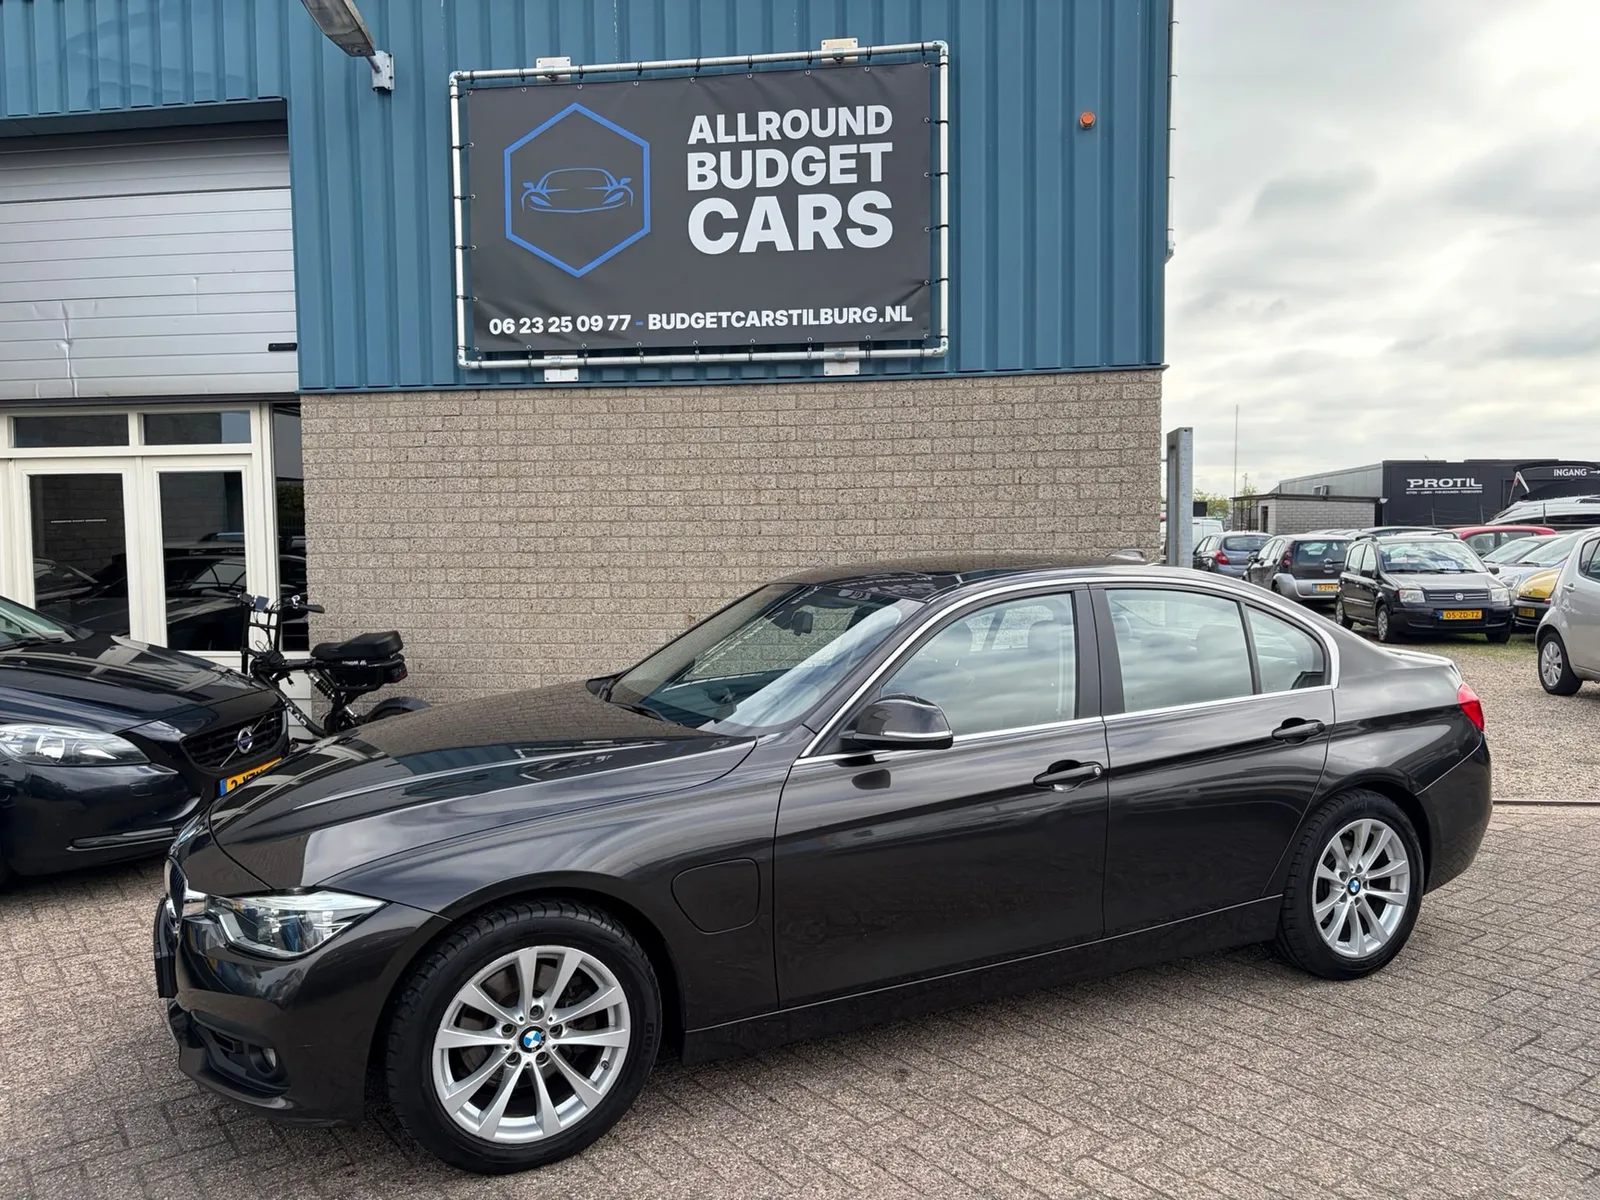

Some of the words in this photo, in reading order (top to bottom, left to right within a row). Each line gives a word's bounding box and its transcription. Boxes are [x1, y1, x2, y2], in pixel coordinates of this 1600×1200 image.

[687, 104, 893, 145] ALLROUND
[687, 142, 893, 191] BUDGET
[687, 190, 894, 255] CARS
[489, 318, 516, 335] 06
[518, 317, 544, 334] 23
[547, 316, 573, 333] 25
[576, 315, 604, 332] 09
[606, 314, 632, 331] 77
[647, 305, 913, 330] BUDGETCARSTILBURG.NL
[1406, 477, 1483, 488] PROTIL
[1553, 468, 1588, 477] INGANG
